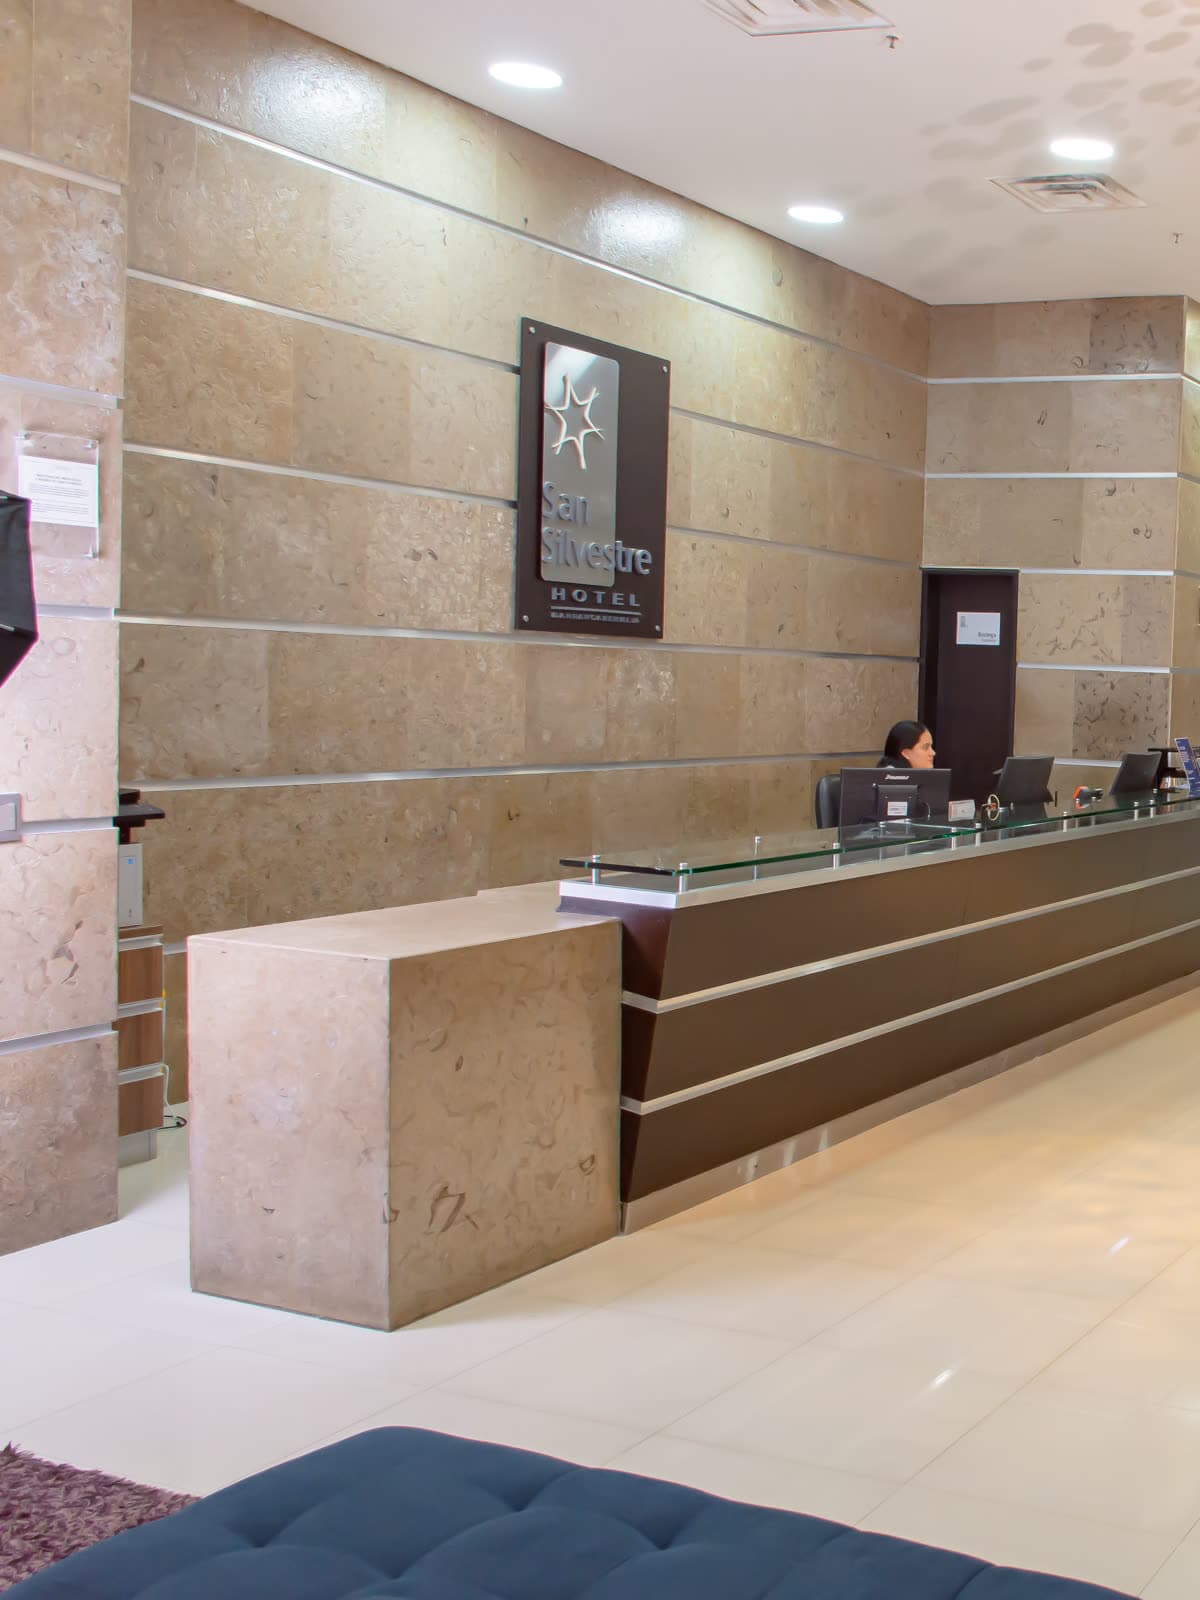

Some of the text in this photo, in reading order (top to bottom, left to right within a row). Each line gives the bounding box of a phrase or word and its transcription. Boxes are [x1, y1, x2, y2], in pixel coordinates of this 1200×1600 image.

[543, 481, 592, 526] San
[542, 526, 652, 575] Silvestre
[551, 587, 641, 607] HOTEL
